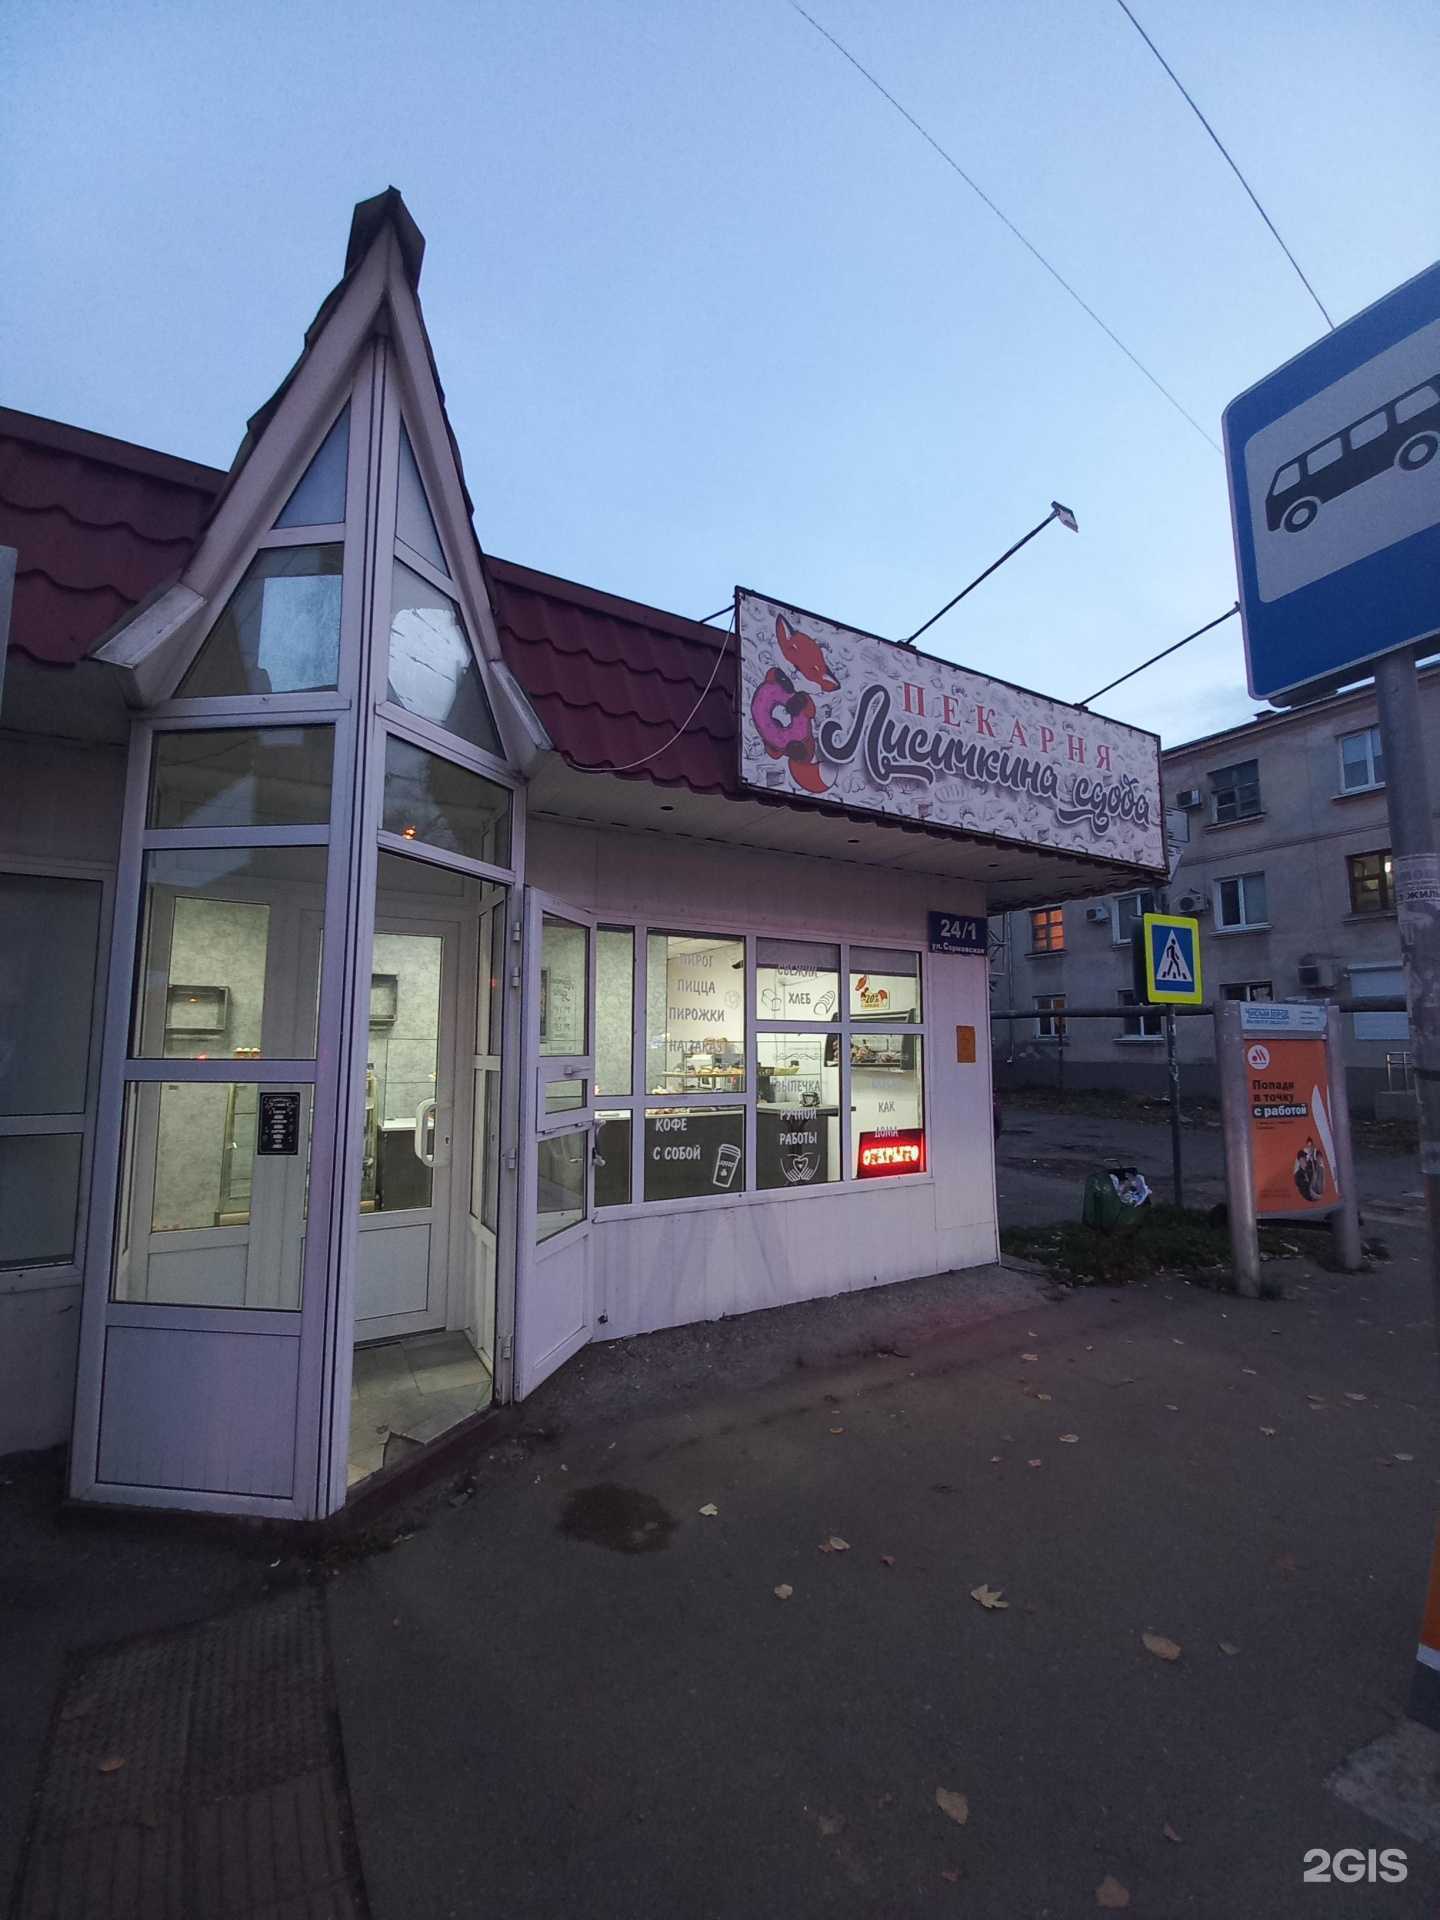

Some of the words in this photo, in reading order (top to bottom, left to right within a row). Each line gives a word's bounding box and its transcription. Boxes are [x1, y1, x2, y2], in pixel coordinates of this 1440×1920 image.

[902, 682, 1113, 772] ПЕКАРНЯ
[820, 684, 1058, 799] Лисичкина
[1057, 774, 1151, 833] сдоба
[940, 919, 976, 940] 24/1
[678, 979, 716, 996] ПИЦЦА
[788, 992, 812, 1005] ХЛЕБ
[668, 1007, 725, 1022] ПИРОЖКИ
[776, 1079, 821, 1093] ВЫПЕЧКА
[1253, 1080, 1295, 1090] Попади
[1264, 1093, 1295, 1103] точку
[780, 1107, 817, 1121] РУЧНОЙ
[878, 1101, 896, 1113] КАК
[1254, 1108, 1262, 1116] с
[1263, 1103, 1308, 1118] работой
[655, 1118, 688, 1132] КОФЕ
[779, 1132, 818, 1145] РАБОТЫ
[653, 1147, 660, 1160] С
[664, 1145, 701, 1160] СОБОЙ
[862, 1145, 920, 1167] ОТКРЫТО
